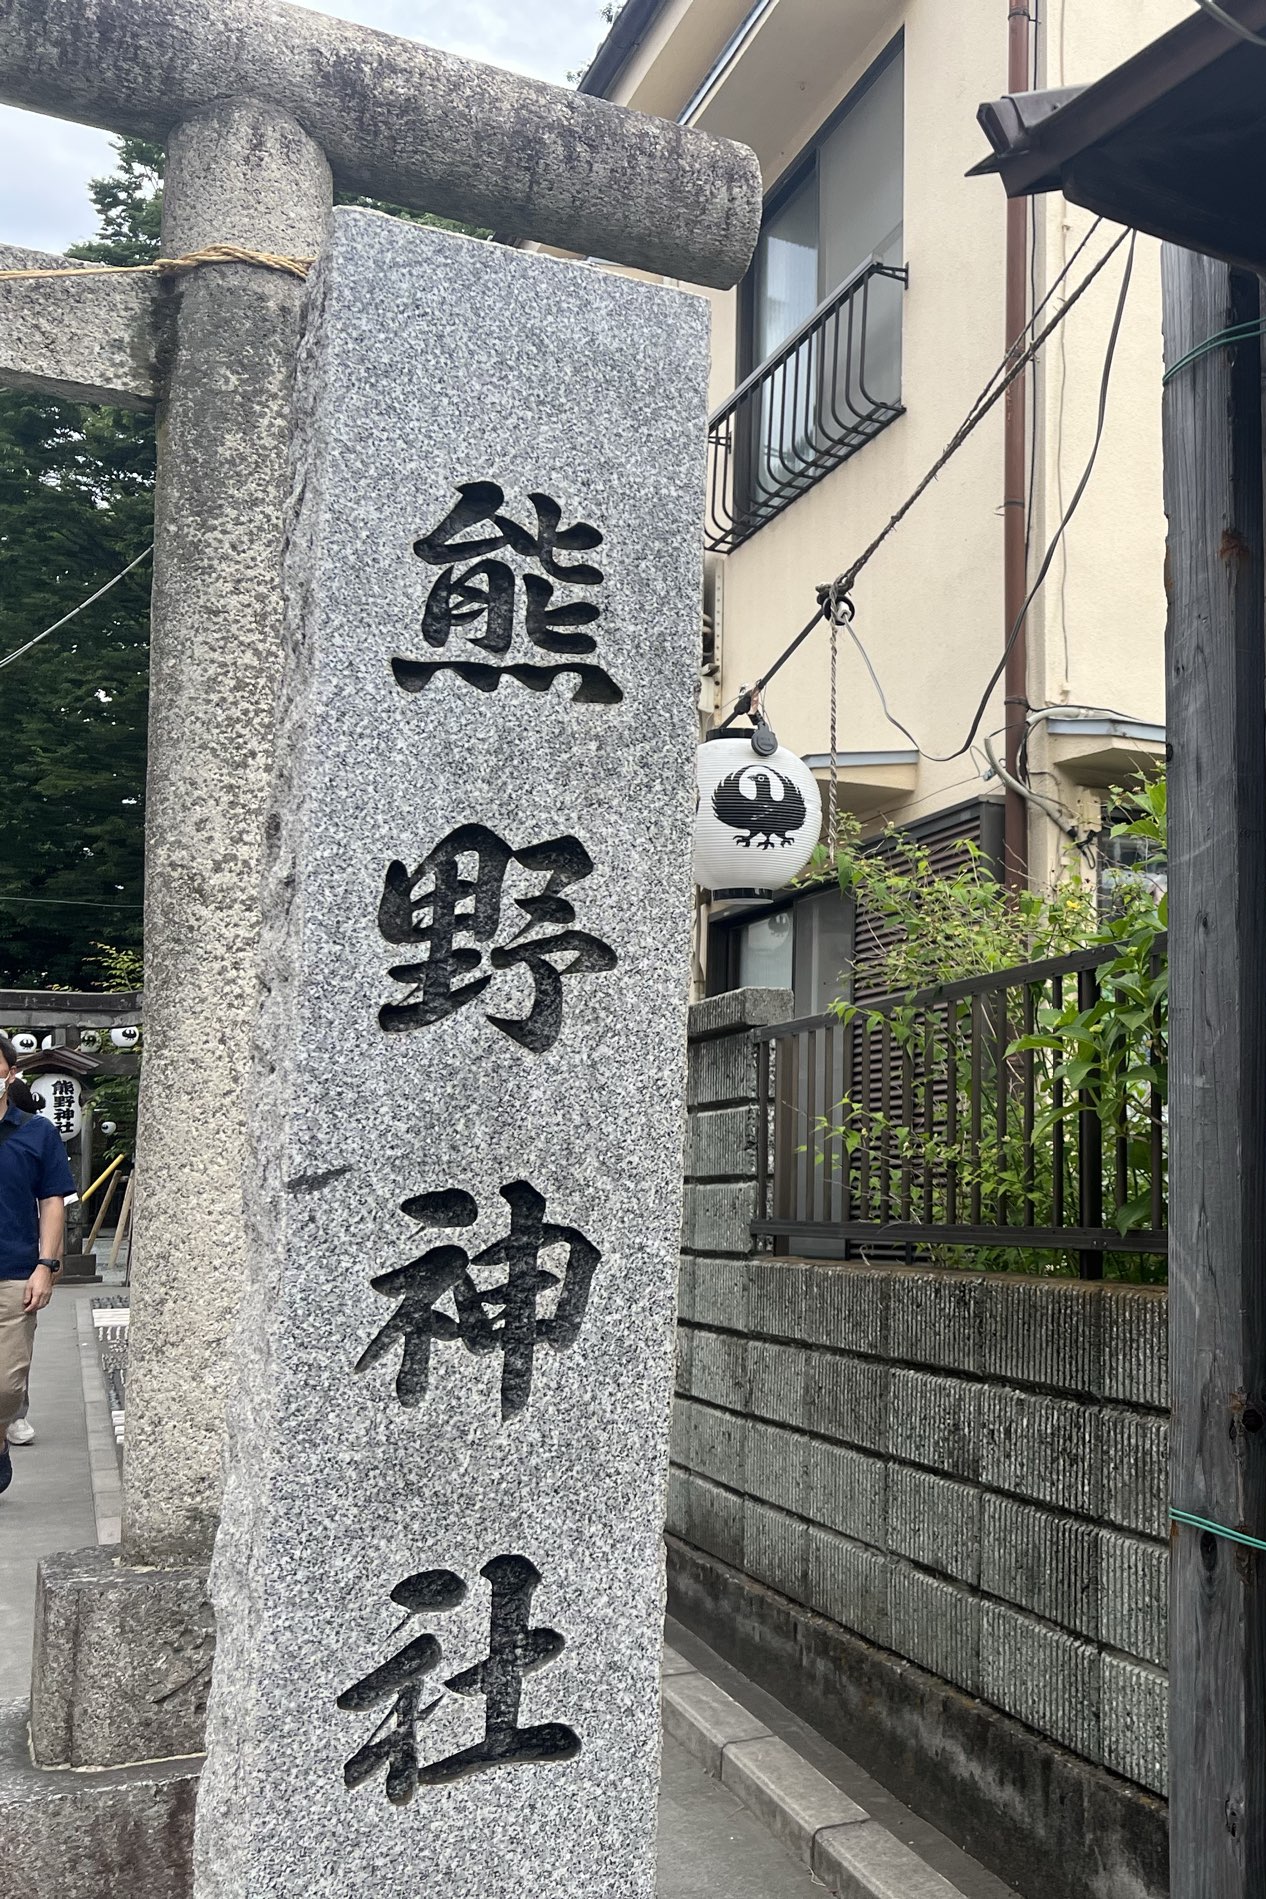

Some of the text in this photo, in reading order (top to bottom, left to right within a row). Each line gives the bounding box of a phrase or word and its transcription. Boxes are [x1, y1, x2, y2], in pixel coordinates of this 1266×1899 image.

[51, 1080, 75, 1133] 熊野神社
[337, 480, 623, 1806] 熊野神社
